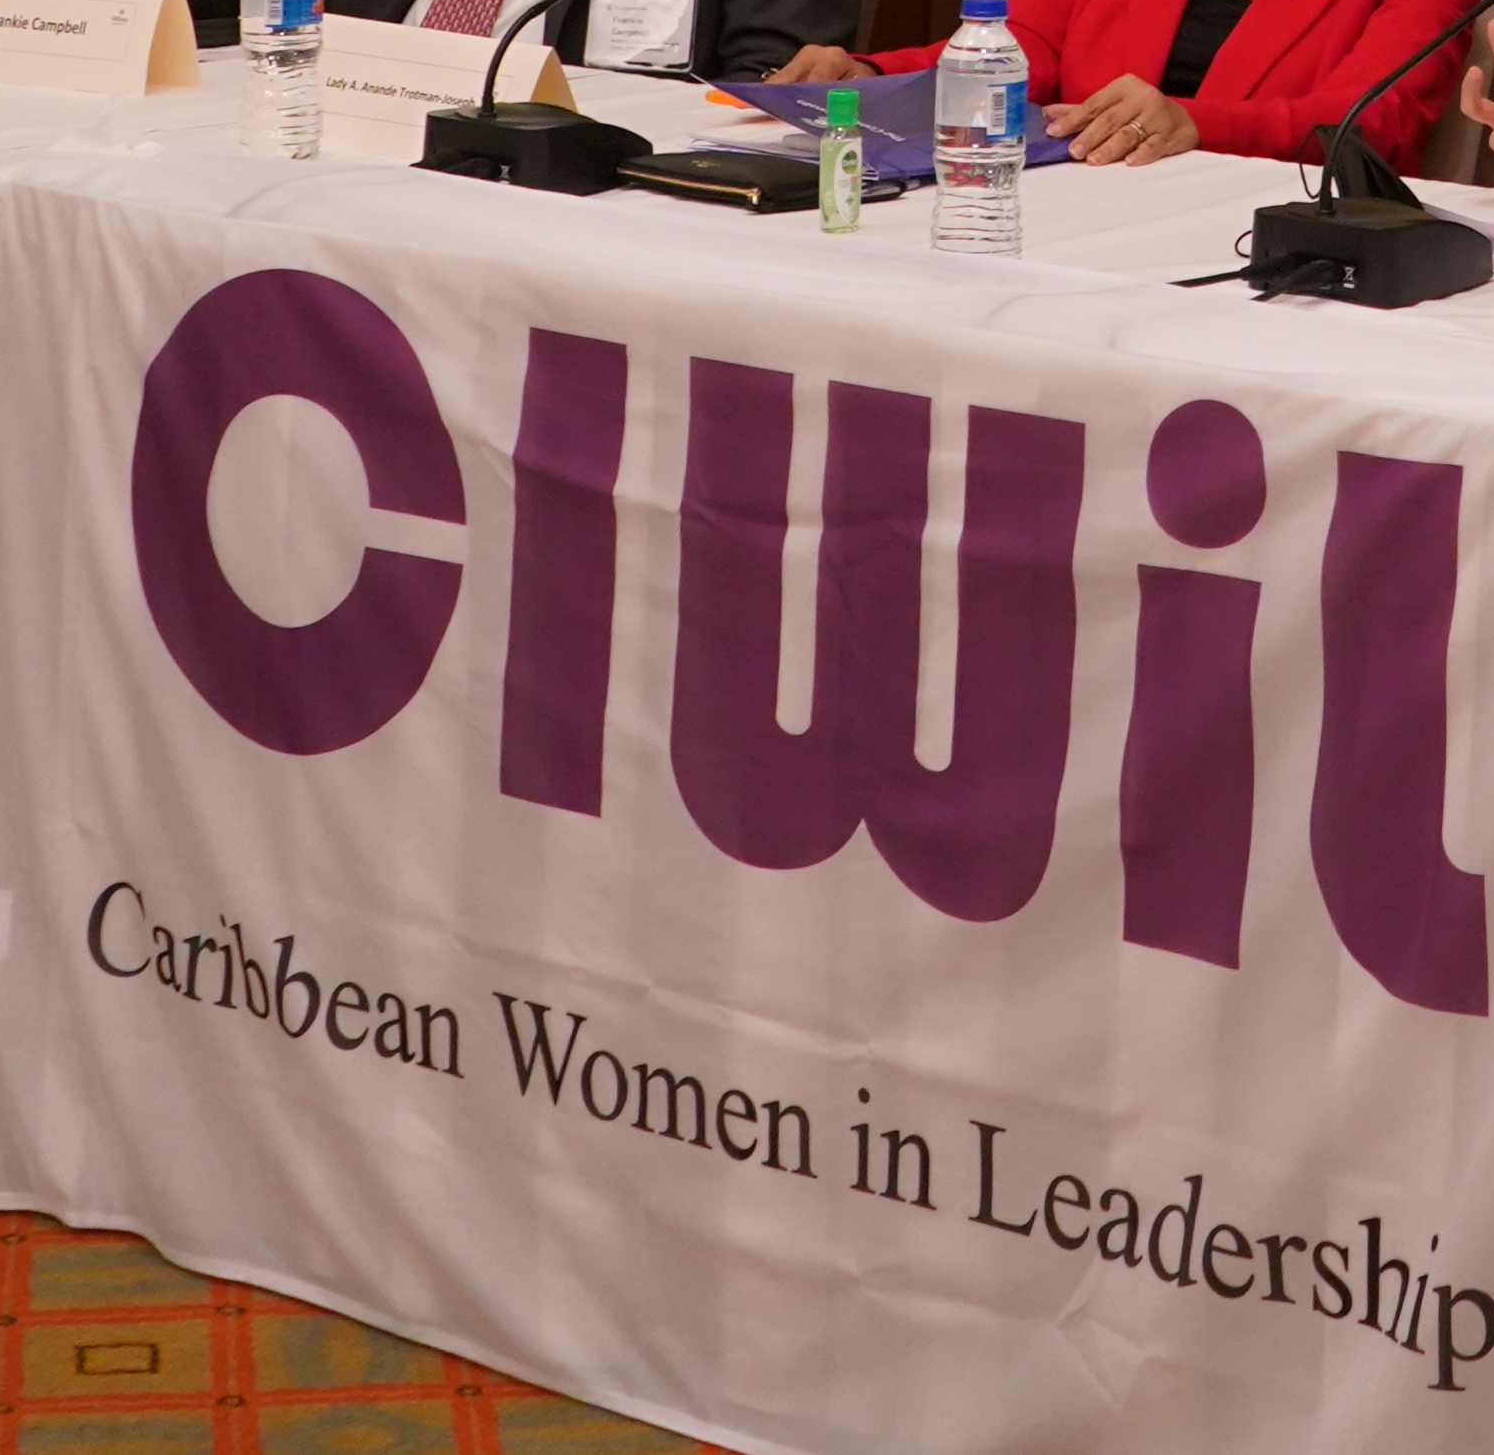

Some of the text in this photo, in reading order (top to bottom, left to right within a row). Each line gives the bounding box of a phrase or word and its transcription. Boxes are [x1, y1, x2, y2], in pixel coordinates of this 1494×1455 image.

[31, 16, 87, 36] Campbell
[326, 76, 347, 91] Lady
[362, 82, 397, 98] Anande
[399, 86, 476, 107] Trotman-Joseph
[86, 880, 466, 1080] Caribbean
[491, 990, 816, 1179] Women
[848, 1087, 937, 1211] in
